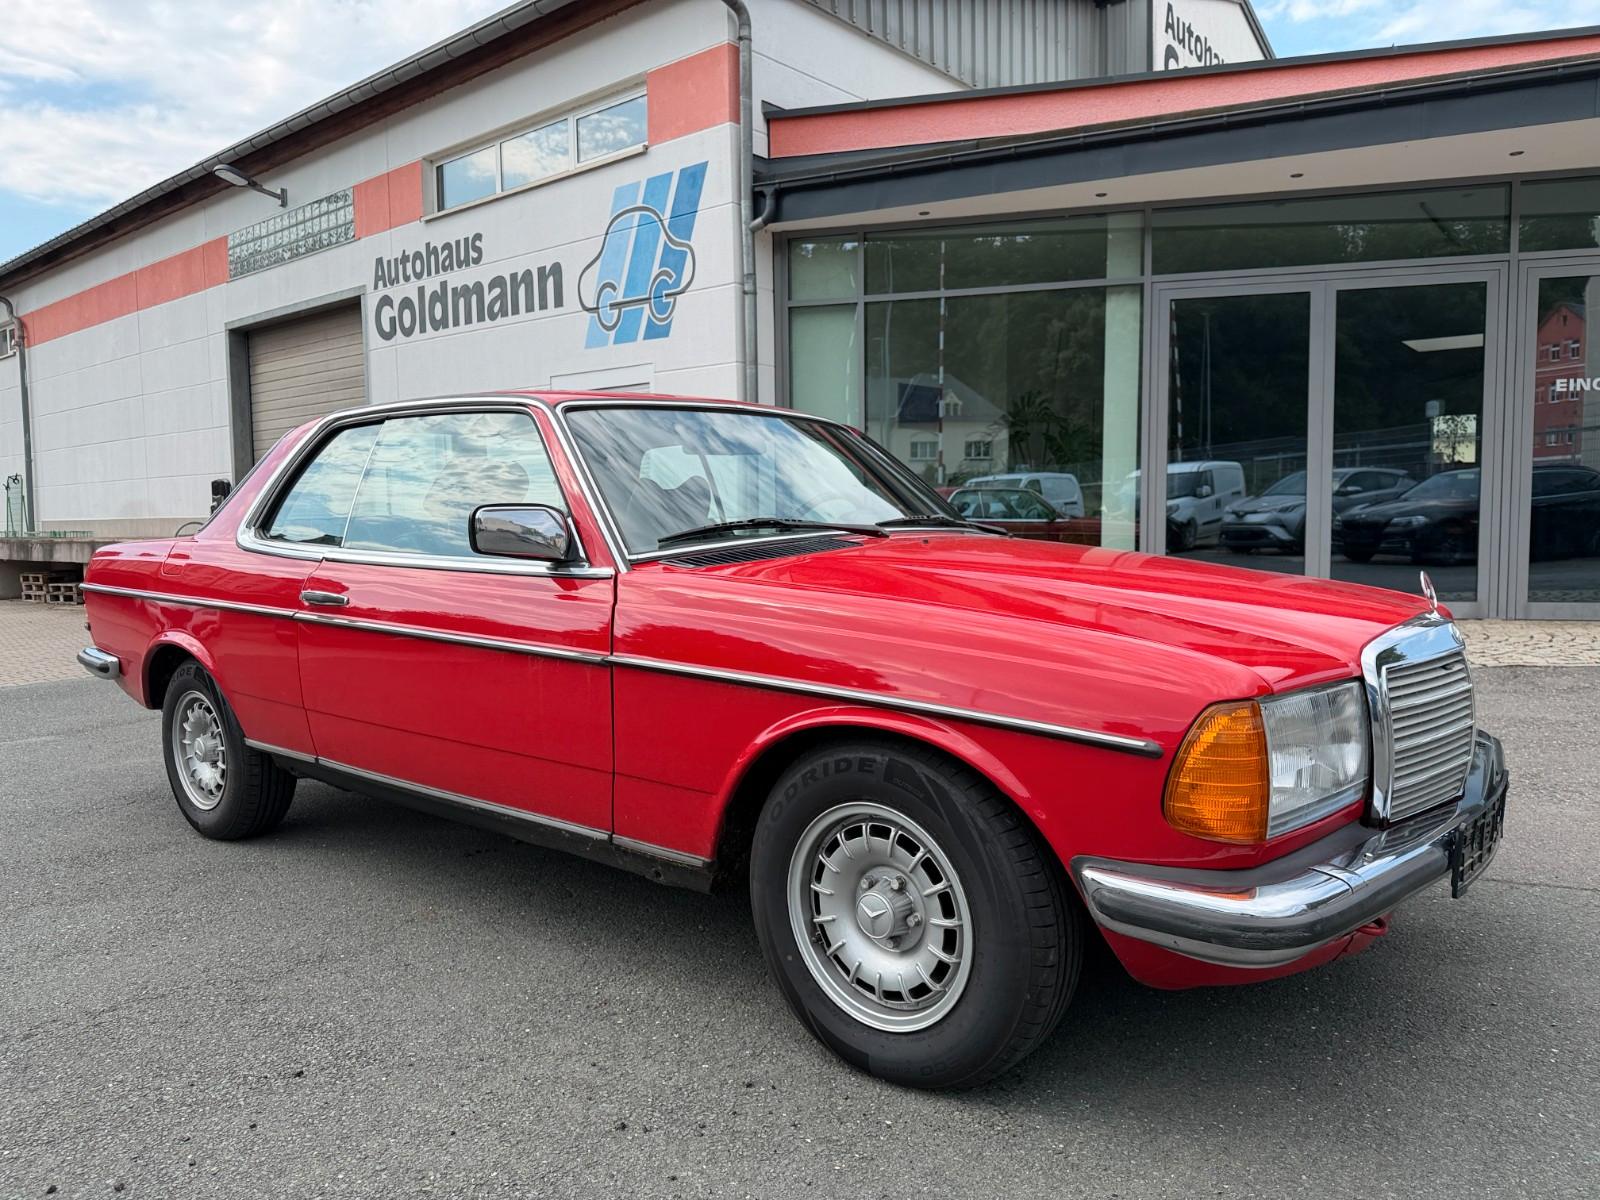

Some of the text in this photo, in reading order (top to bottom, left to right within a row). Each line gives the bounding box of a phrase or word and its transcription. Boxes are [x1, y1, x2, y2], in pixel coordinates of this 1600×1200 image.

[373, 232, 483, 291] Autohaus
[374, 261, 564, 341] Goldmann
[768, 756, 879, 826] ODRIDE
